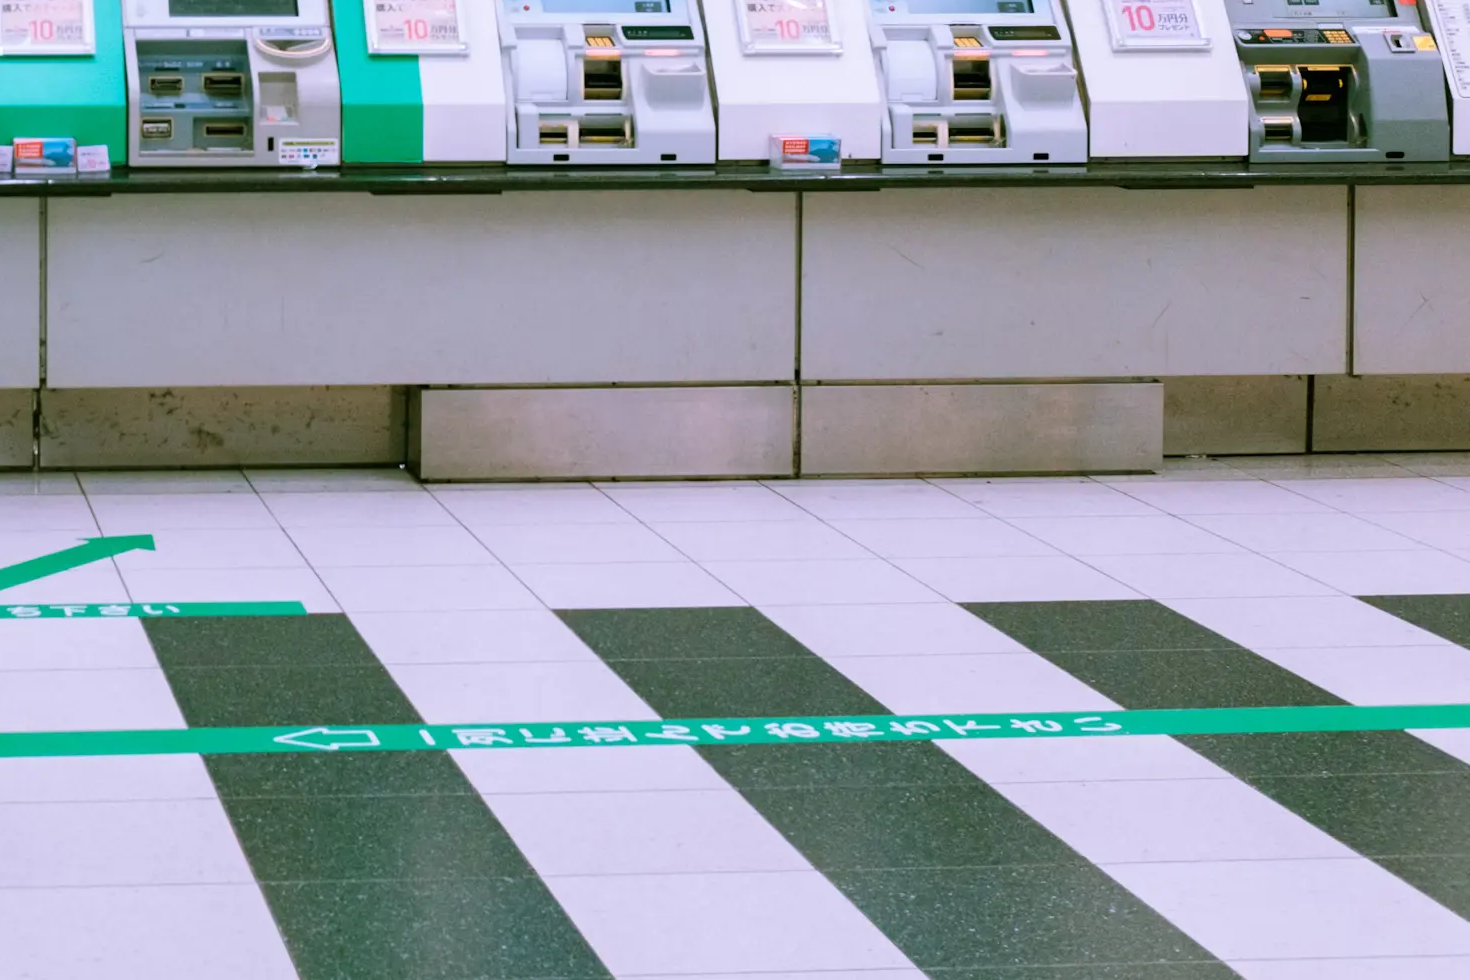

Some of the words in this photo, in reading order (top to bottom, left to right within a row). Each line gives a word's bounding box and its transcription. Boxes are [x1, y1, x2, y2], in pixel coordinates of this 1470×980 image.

[403, 18, 429, 41] 10
[775, 18, 801, 40] 10
[1121, 4, 1156, 32] 10
